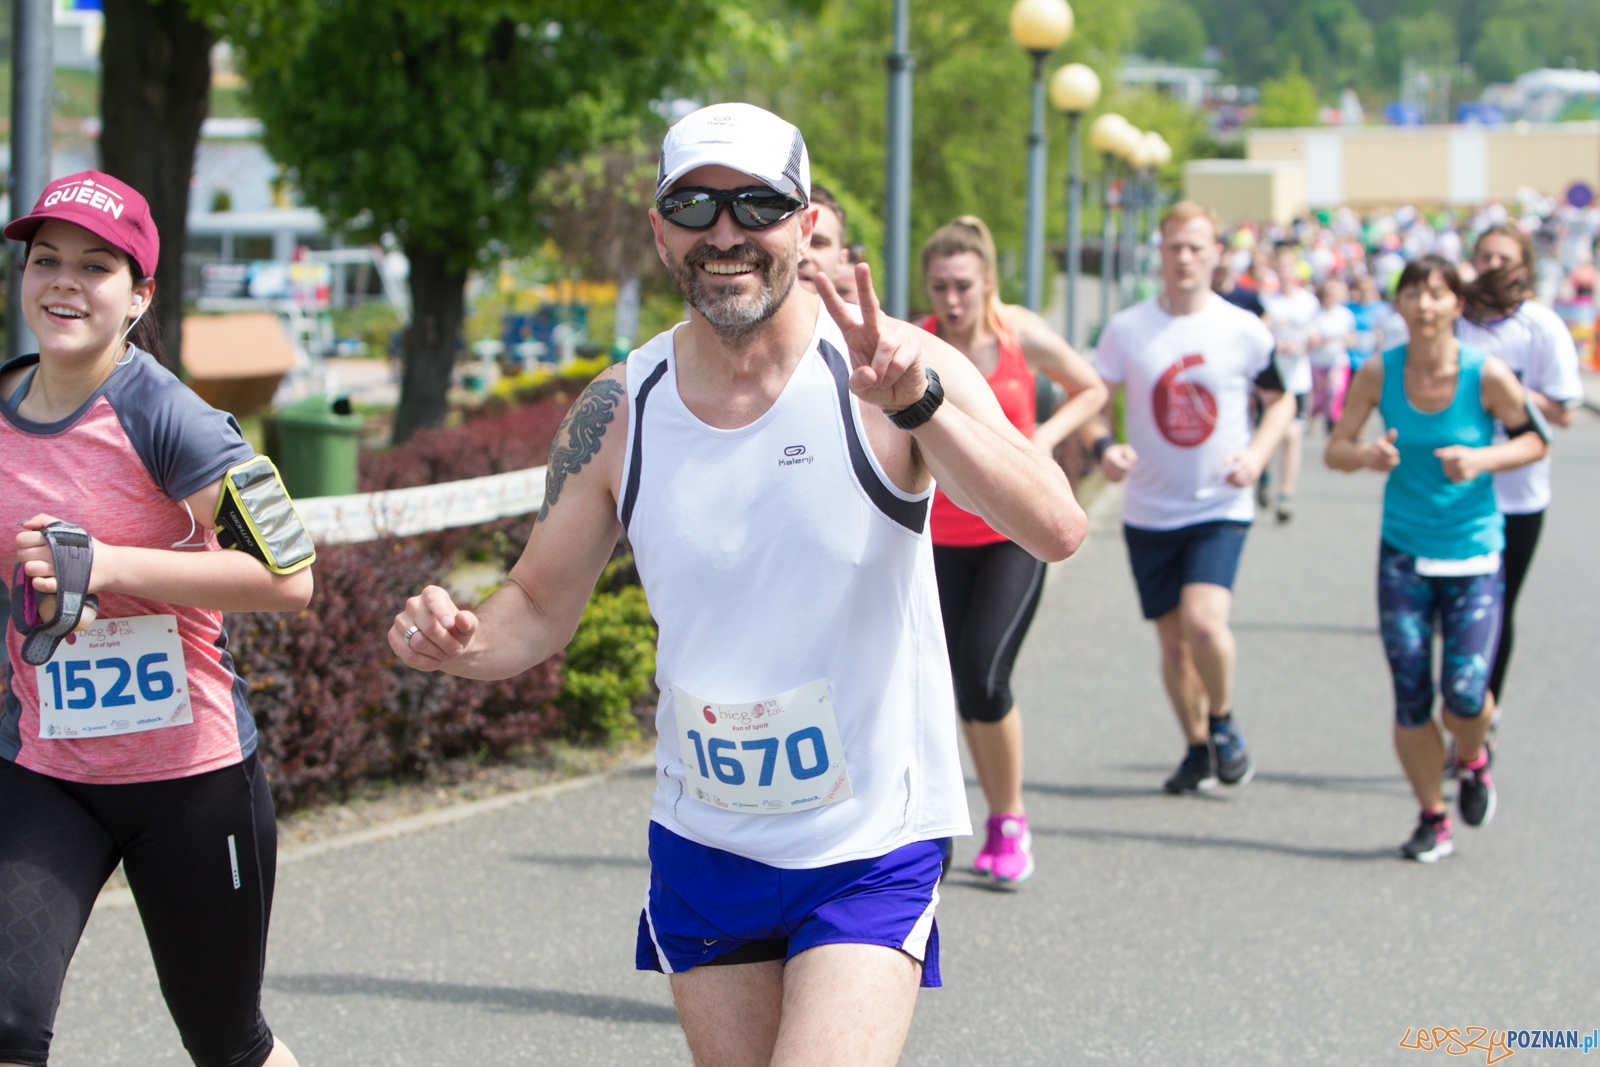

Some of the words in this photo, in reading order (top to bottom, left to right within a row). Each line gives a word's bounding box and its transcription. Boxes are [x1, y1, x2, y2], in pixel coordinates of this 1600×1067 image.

[43, 186, 125, 220] QUEEN
[778, 455, 814, 467] Kalenji
[117, 620, 129, 628] na
[119, 626, 136, 635] tak
[106, 641, 121, 649] Spirit
[45, 652, 175, 710] 1526
[717, 706, 752, 725] bieg
[764, 699, 777, 708] na
[766, 705, 785, 717] tak
[752, 722, 769, 731] Spirit
[686, 726, 830, 787] 1670
